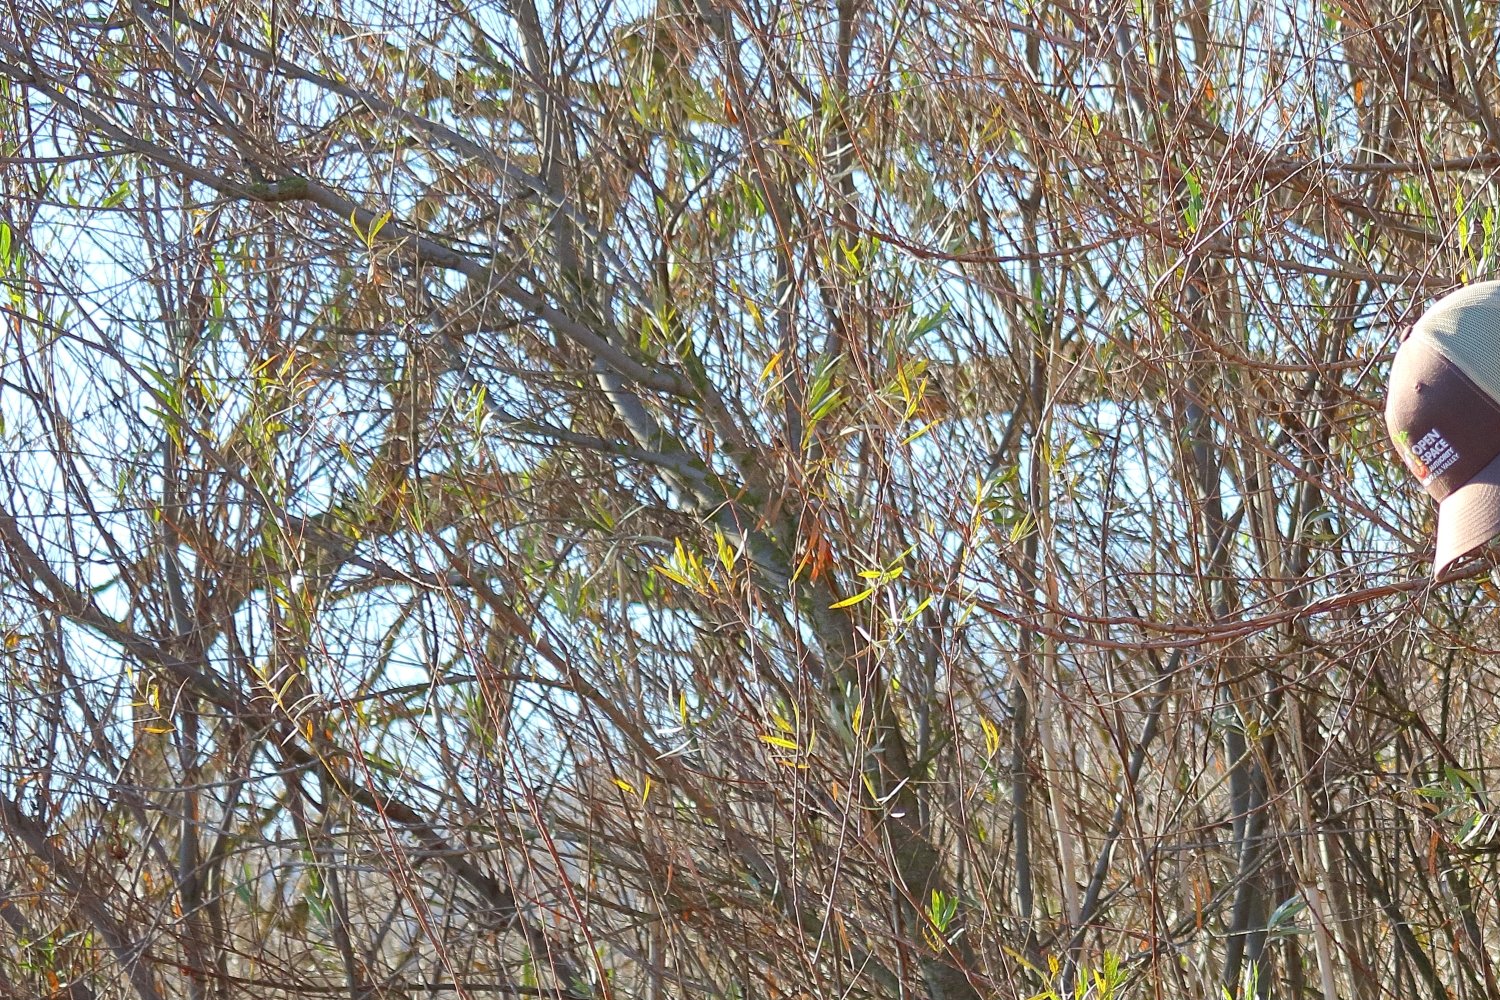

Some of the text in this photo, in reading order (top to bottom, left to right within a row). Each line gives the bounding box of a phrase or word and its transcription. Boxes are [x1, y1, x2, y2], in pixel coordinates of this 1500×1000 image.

[1411, 428, 1440, 456] OPEN
[1420, 438, 1449, 465] SPACE
[1429, 447, 1454, 472] AUTHORITY
[1441, 453, 1460, 470] VALLEY
